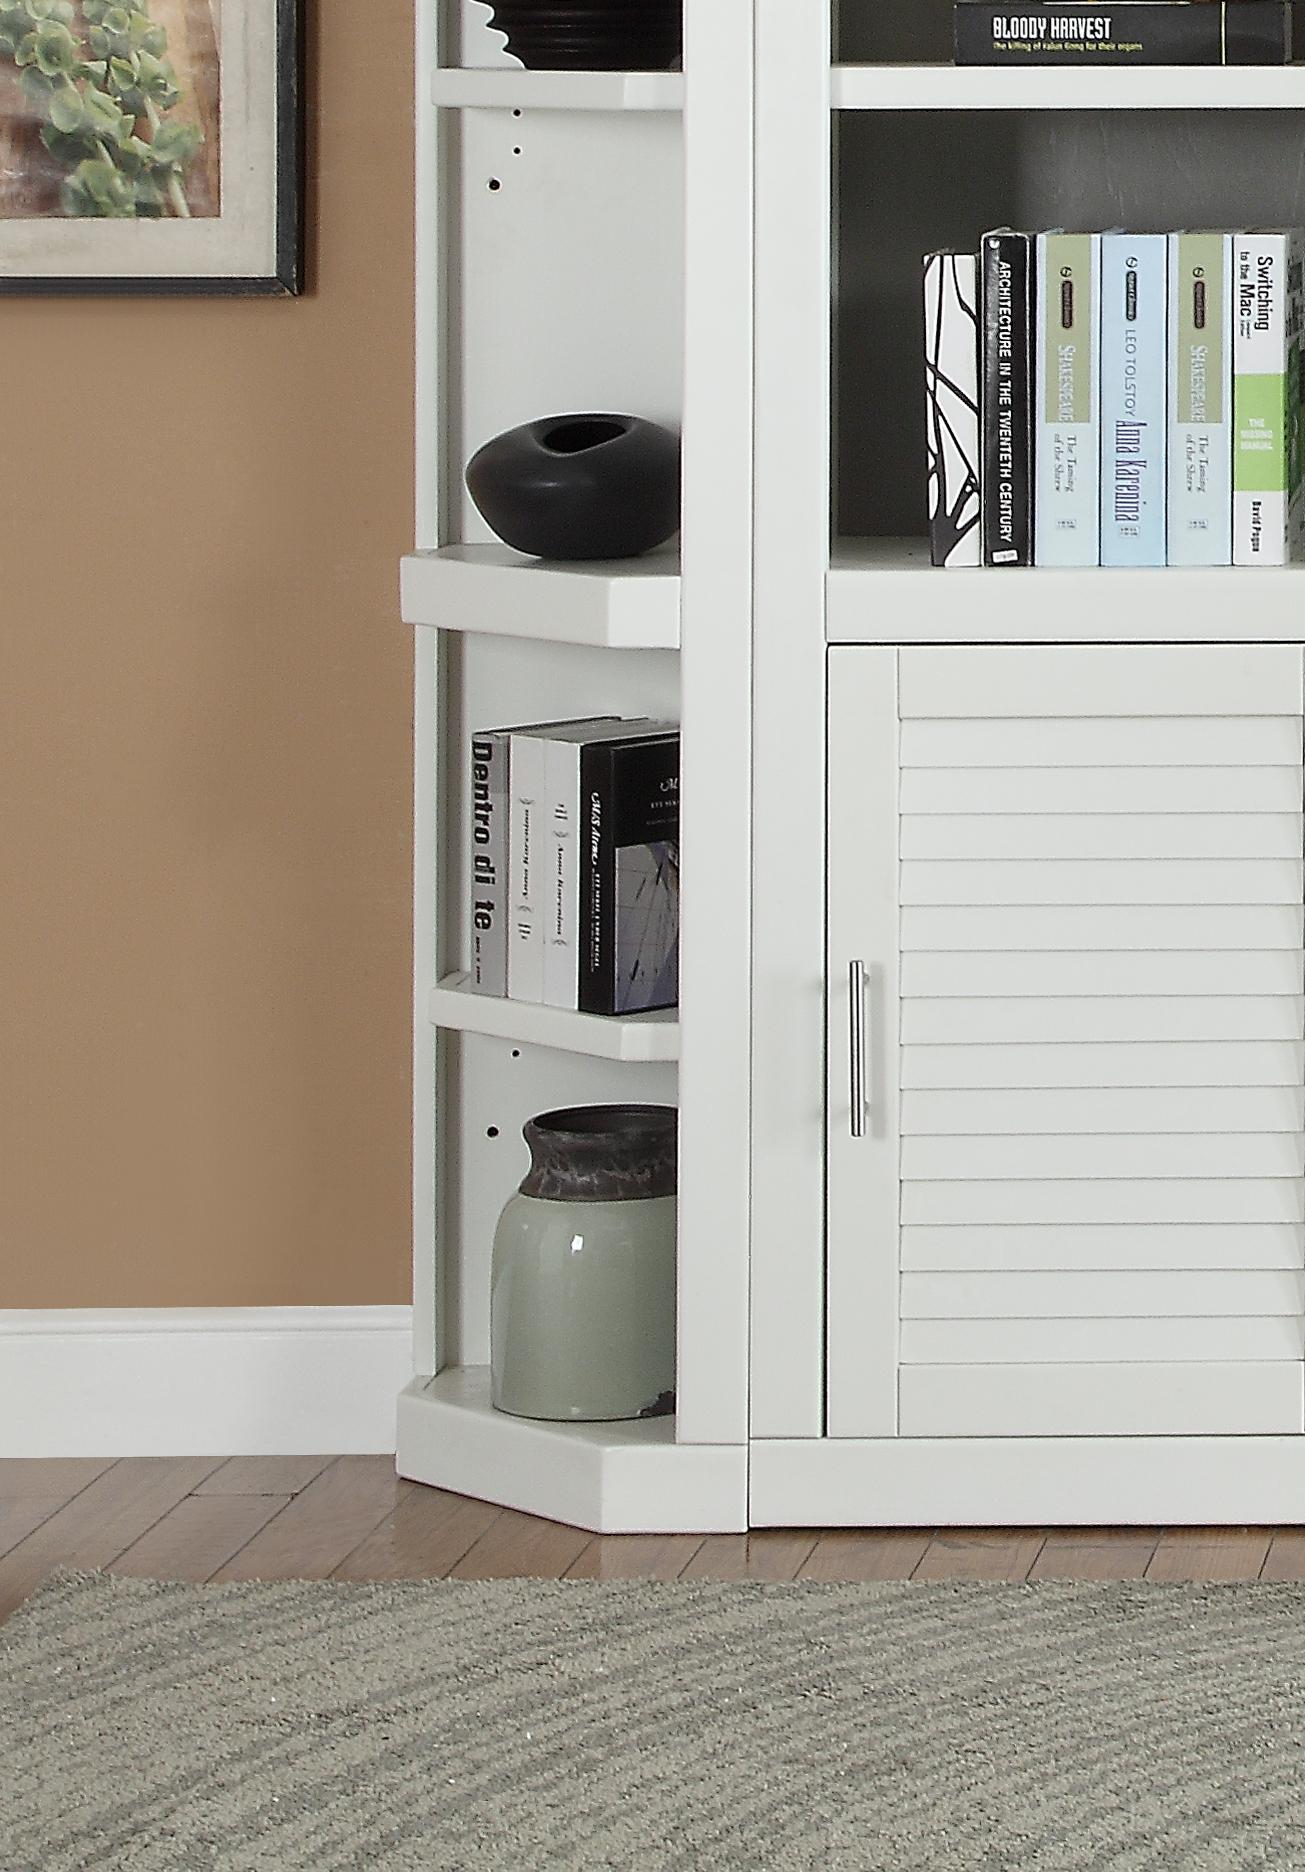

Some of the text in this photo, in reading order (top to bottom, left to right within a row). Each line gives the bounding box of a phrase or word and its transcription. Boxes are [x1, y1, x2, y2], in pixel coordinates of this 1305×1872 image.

[992, 17, 1112, 39] BLOODY HARVEST
[1239, 251, 1250, 262] to
[1239, 264, 1250, 279] the
[1240, 283, 1255, 317] Mac
[1254, 255, 1274, 330] Switching
[999, 261, 1012, 357] ARCHITECTURE
[1125, 329, 1137, 355] LEO
[999, 362, 1012, 376] IN
[999, 380, 1012, 406] THE
[1124, 359, 1137, 417] TOLSTOY
[1115, 420, 1148, 522] Anna Karenina
[999, 482, 1013, 543] CENTURY
[1252, 501, 1262, 525] David
[472, 740, 496, 931] Dentro di te
